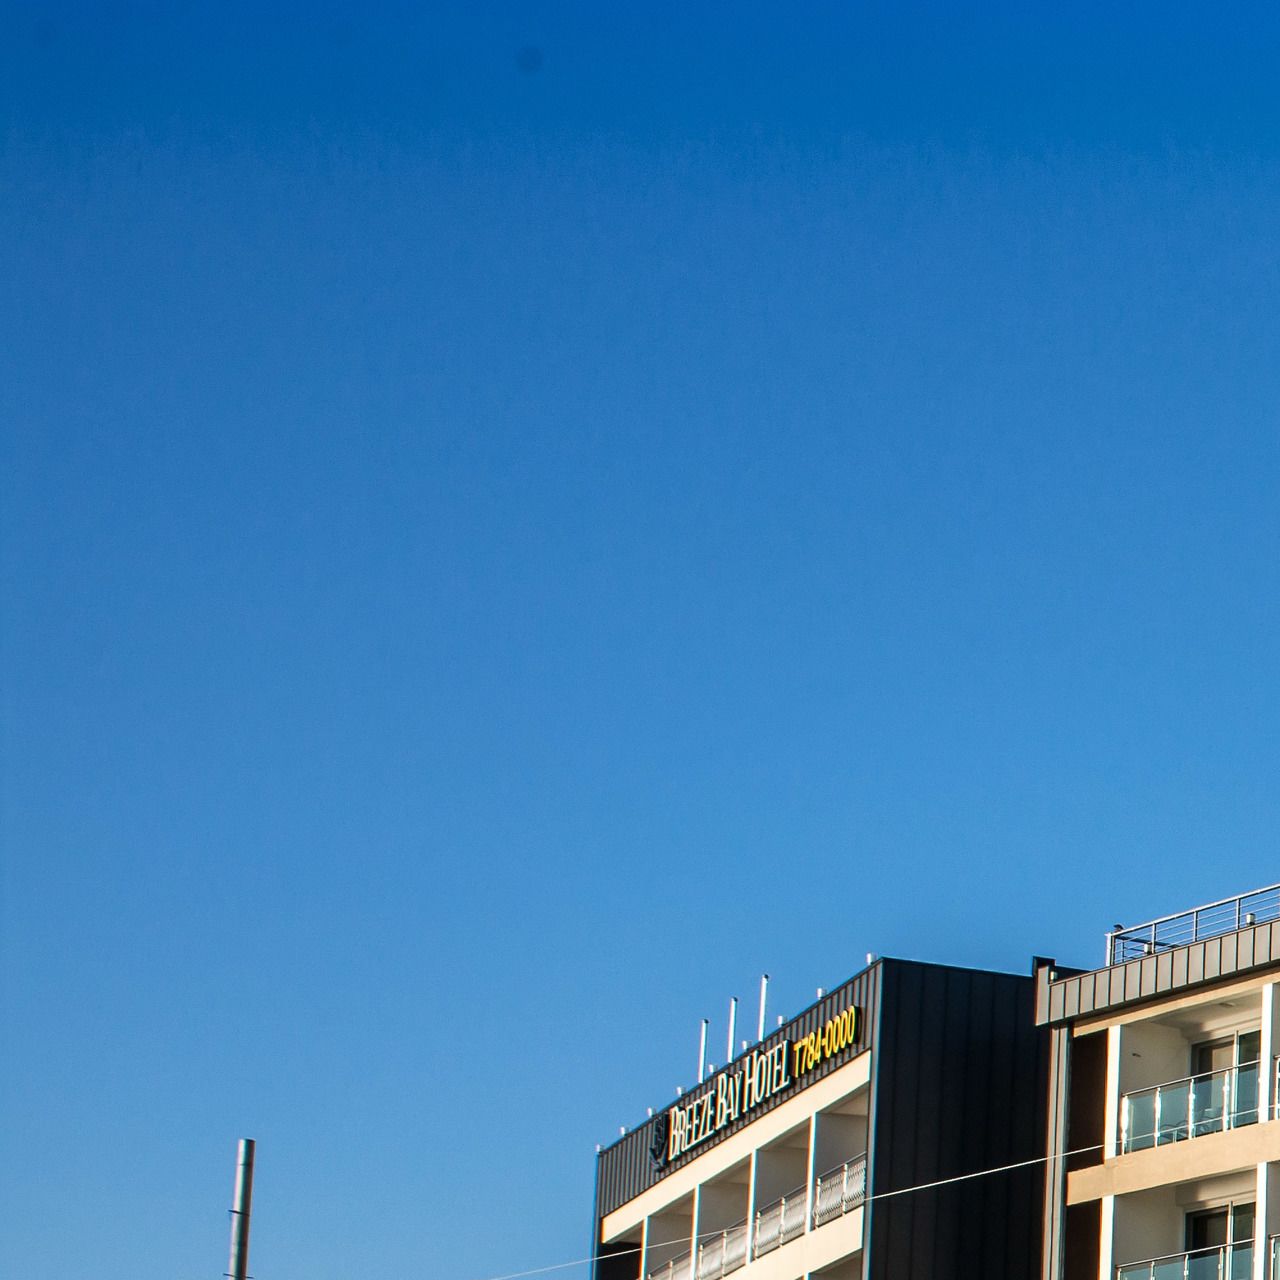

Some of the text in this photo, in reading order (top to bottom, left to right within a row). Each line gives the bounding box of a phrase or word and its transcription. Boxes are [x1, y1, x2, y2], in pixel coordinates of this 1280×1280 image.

[668, 1089, 717, 1160] BREEZE
[716, 1071, 743, 1130] BAY
[742, 1040, 791, 1113] HOTEL
